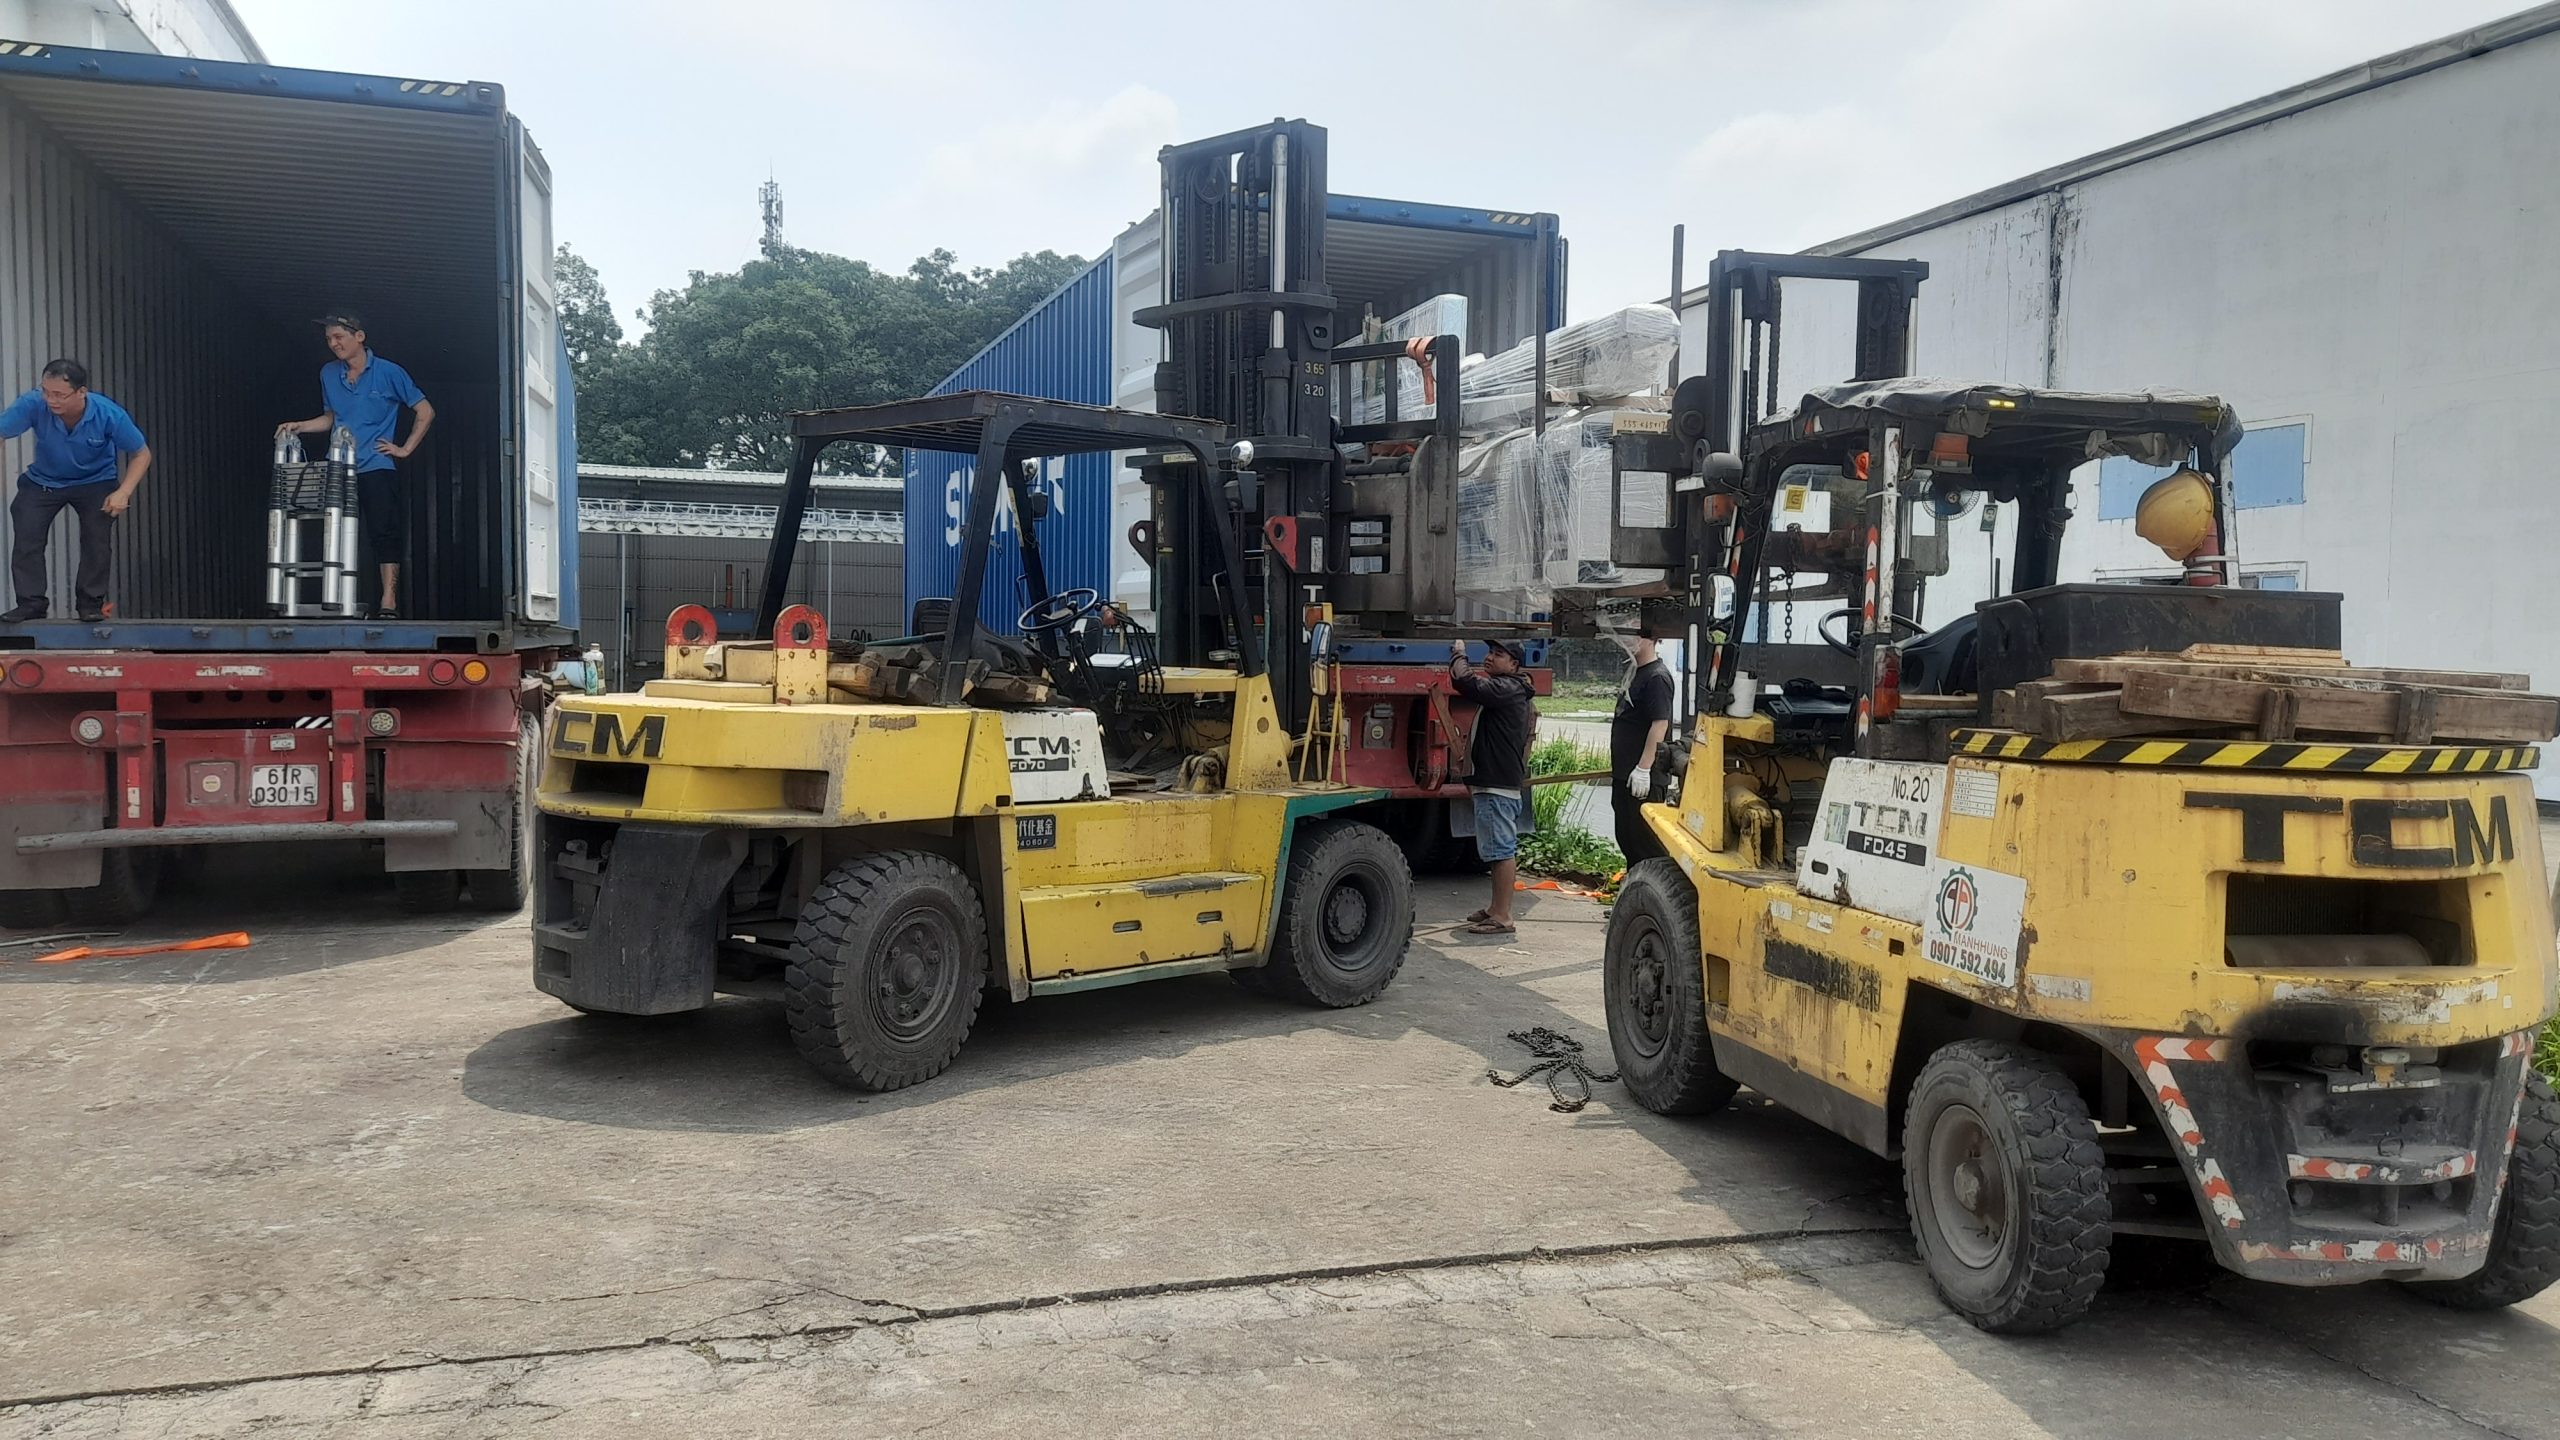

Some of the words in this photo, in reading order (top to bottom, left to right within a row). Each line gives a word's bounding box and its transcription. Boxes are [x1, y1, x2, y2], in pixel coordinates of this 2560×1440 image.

[1689, 554, 1701, 607] TCM
[268, 768, 301, 785] 61R
[1010, 760, 1045, 771] FD70
[1891, 774, 1929, 803] No.20
[1854, 800, 1928, 838] TCM
[2184, 790, 2514, 868] TCM
[1862, 835, 1907, 861] FD45
[1930, 939, 2006, 983] 0907.592.494
